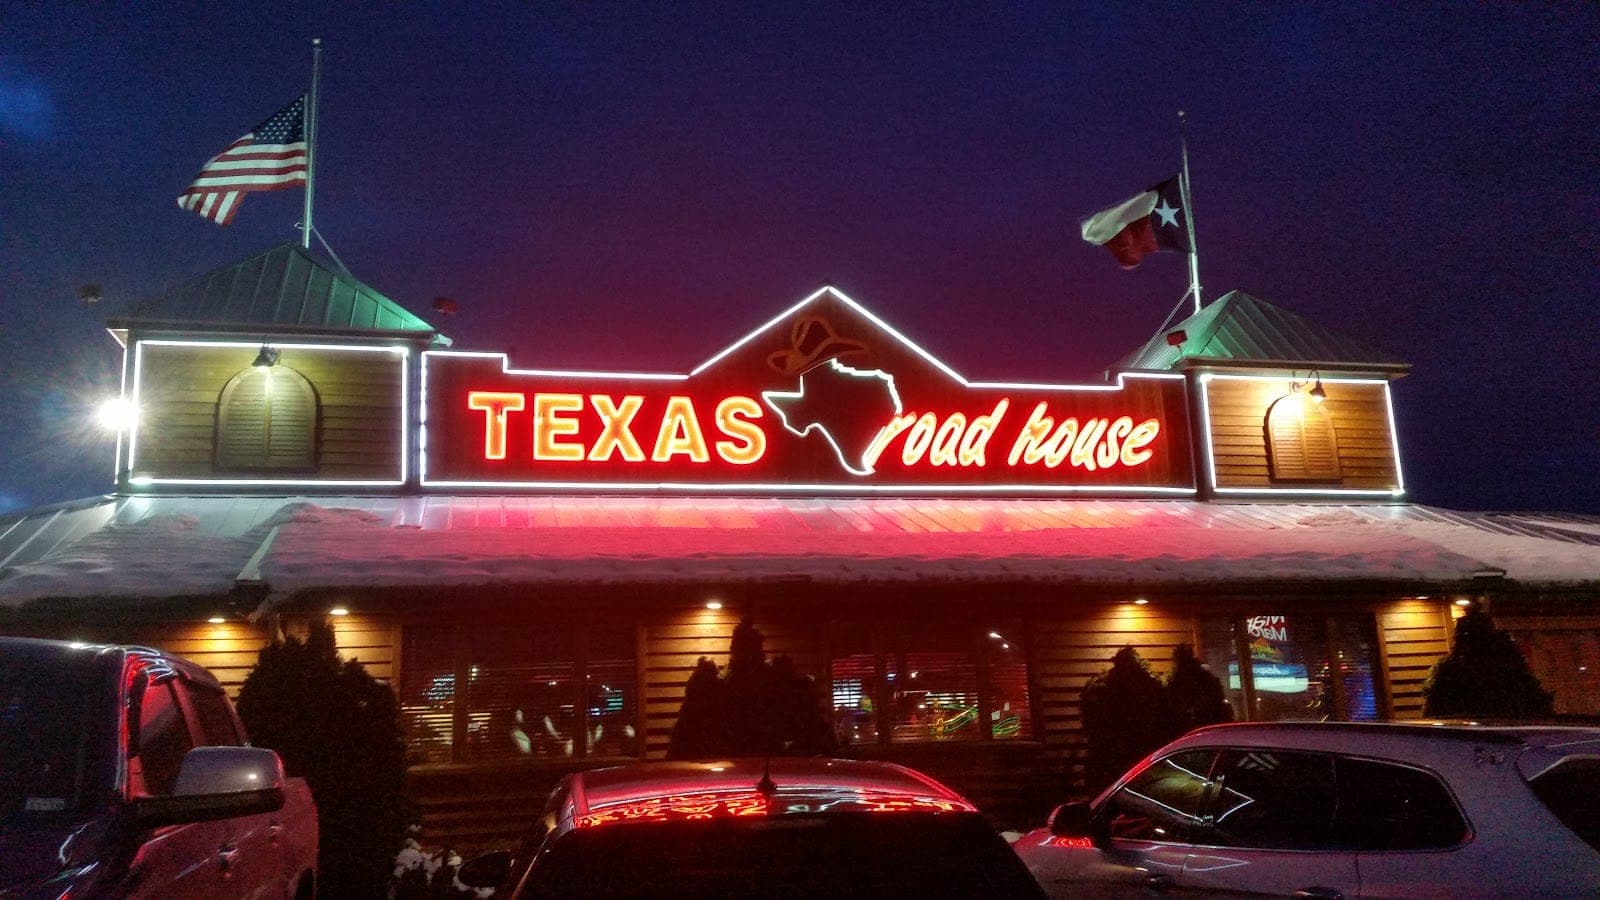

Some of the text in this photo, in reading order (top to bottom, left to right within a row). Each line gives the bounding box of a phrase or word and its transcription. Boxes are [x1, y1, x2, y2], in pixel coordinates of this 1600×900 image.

[468, 391, 1161, 471] TEXAS road house
